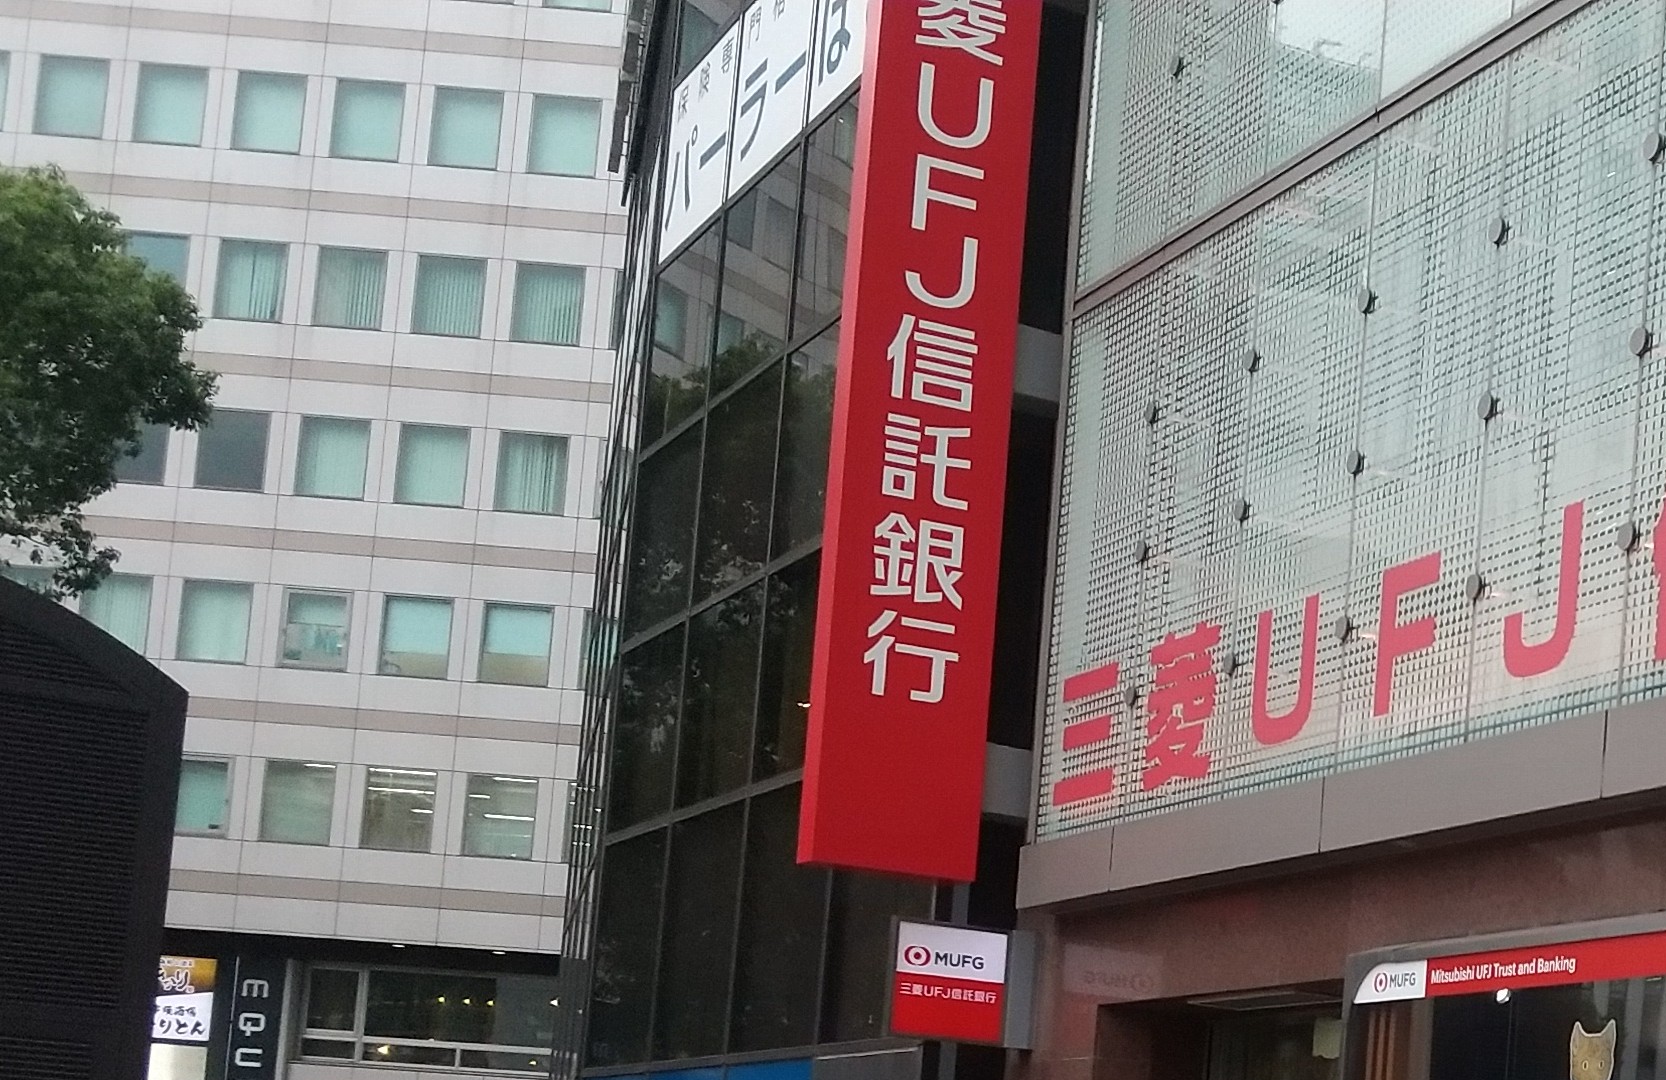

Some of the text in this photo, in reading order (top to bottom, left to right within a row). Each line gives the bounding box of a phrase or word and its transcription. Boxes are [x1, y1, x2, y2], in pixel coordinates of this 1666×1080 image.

[934, 951, 985, 970] MUFG
[1430, 955, 1577, 984] Mitsubishi UFJ Trust and Banking
[1389, 972, 1416, 988] MUFG
[899, 982, 997, 1004] 三菱UFJ信託銀行
[153, 1018, 206, 1036] りとん
